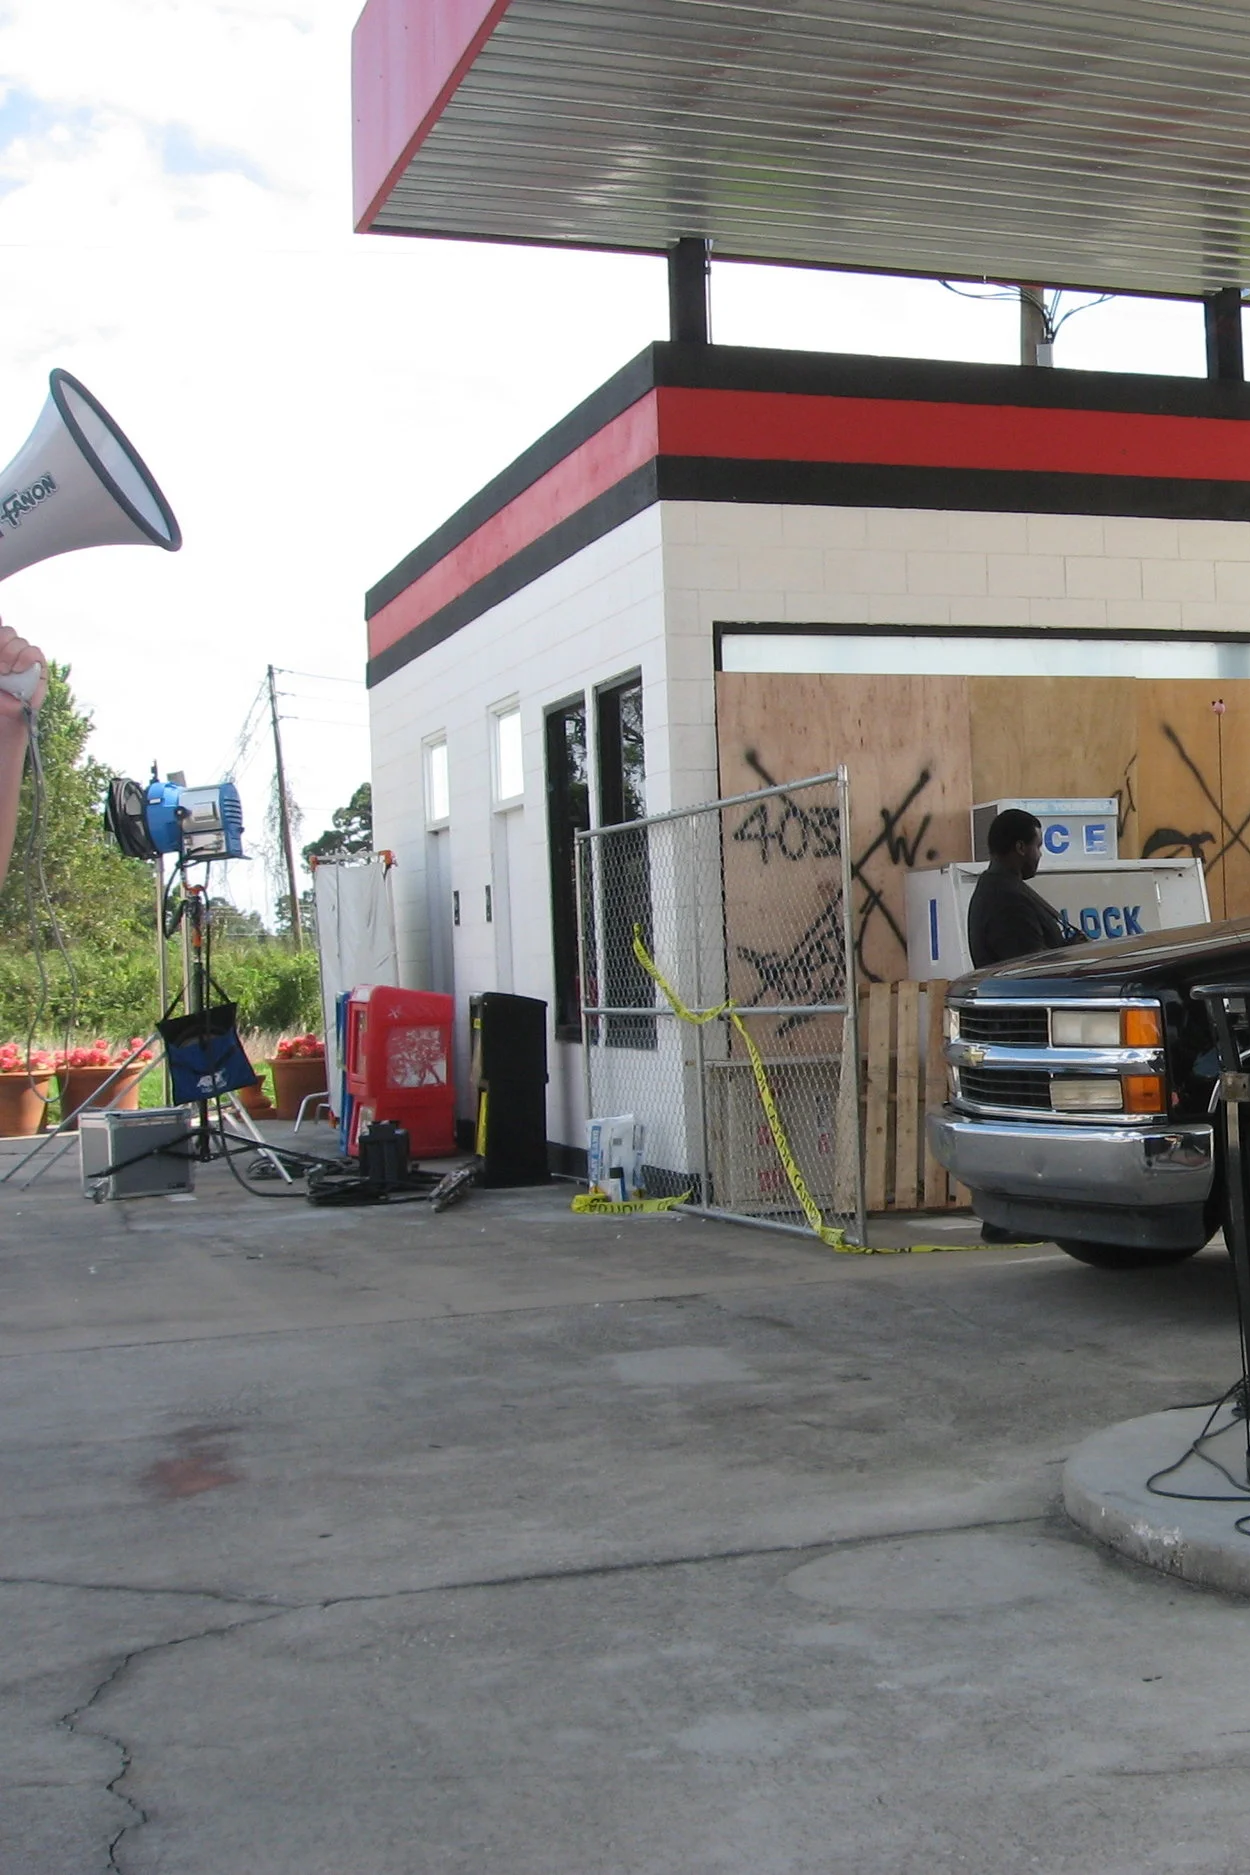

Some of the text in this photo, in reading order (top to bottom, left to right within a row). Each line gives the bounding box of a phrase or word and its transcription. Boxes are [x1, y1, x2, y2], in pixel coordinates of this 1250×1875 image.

[1, 475, 57, 526] FANON
[1044, 824, 1106, 854] CE
[1059, 905, 1144, 940] LOCK
